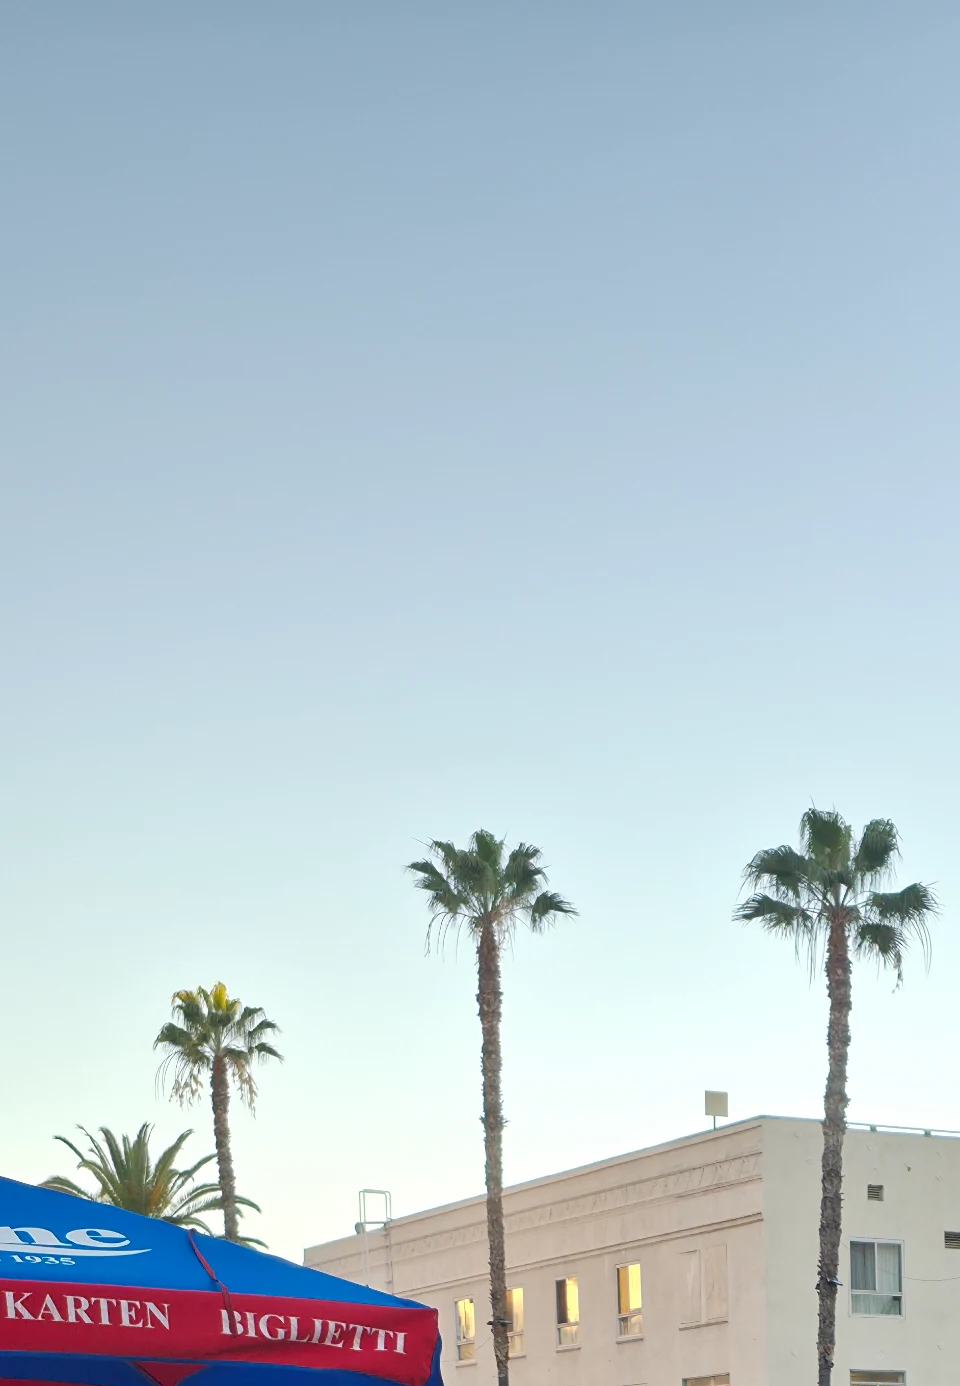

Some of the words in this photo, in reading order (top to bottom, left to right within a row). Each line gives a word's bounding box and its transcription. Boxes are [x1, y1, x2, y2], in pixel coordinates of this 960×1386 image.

[10, 1254, 76, 1267] 1935
[1, 1290, 170, 1331] KARTEN
[220, 1308, 408, 1356] BIGLIETTI
